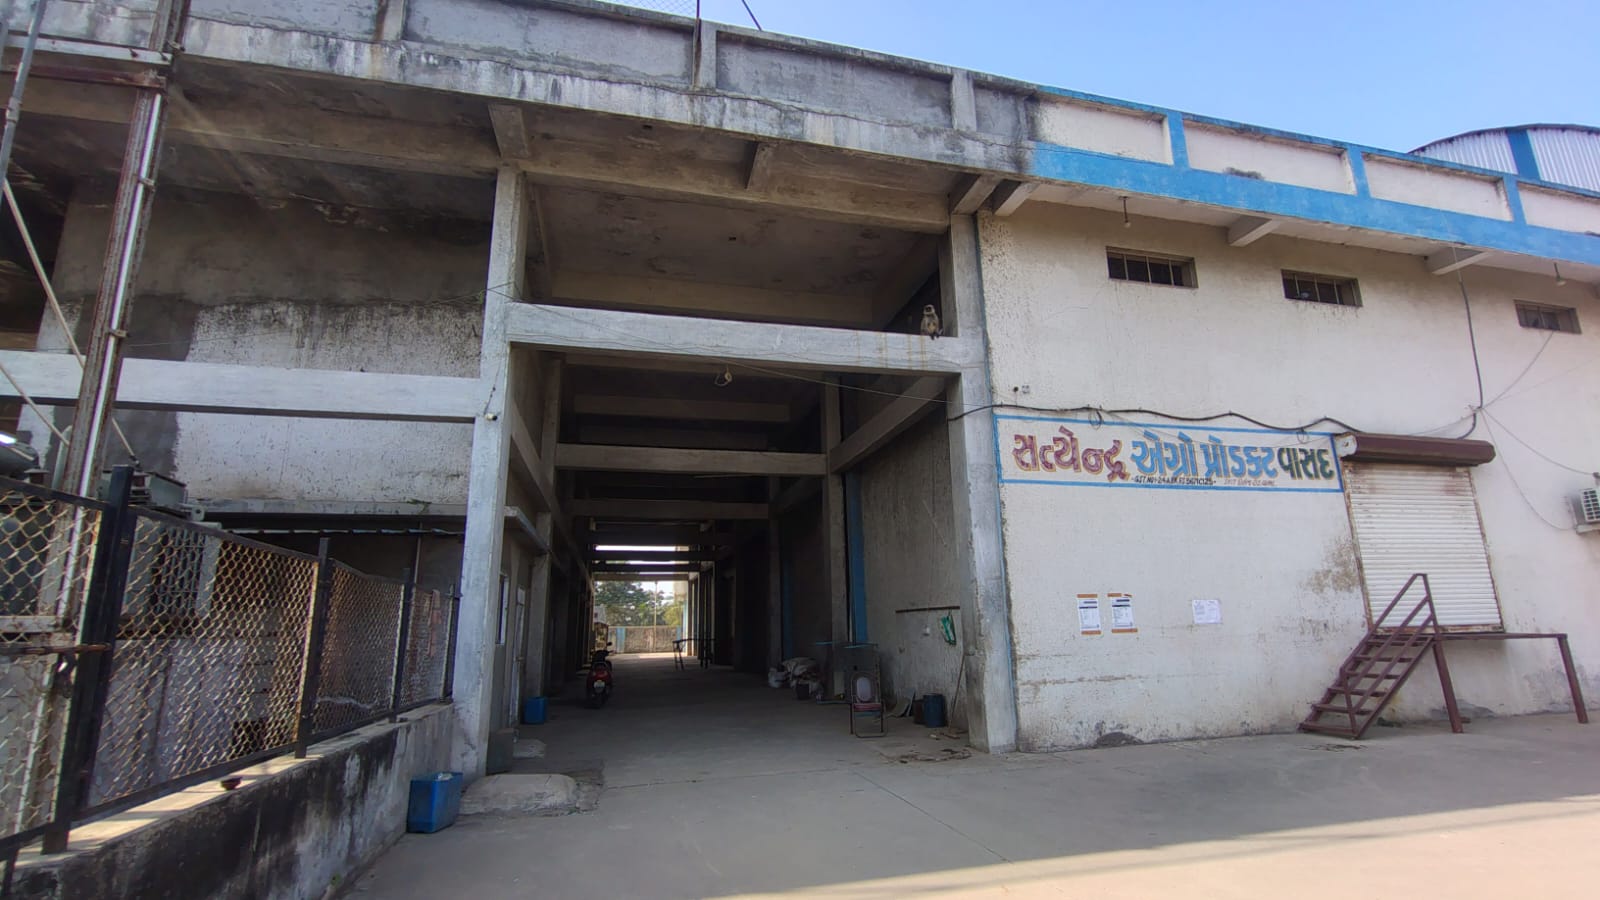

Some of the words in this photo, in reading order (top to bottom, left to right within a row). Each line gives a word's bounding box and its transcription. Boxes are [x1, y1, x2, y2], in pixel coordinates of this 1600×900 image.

[1012, 425, 1130, 482] સત્યેન્દ્ર
[1130, 429, 1199, 476] એગ્રો
[1277, 447, 1335, 480] વાસદ
